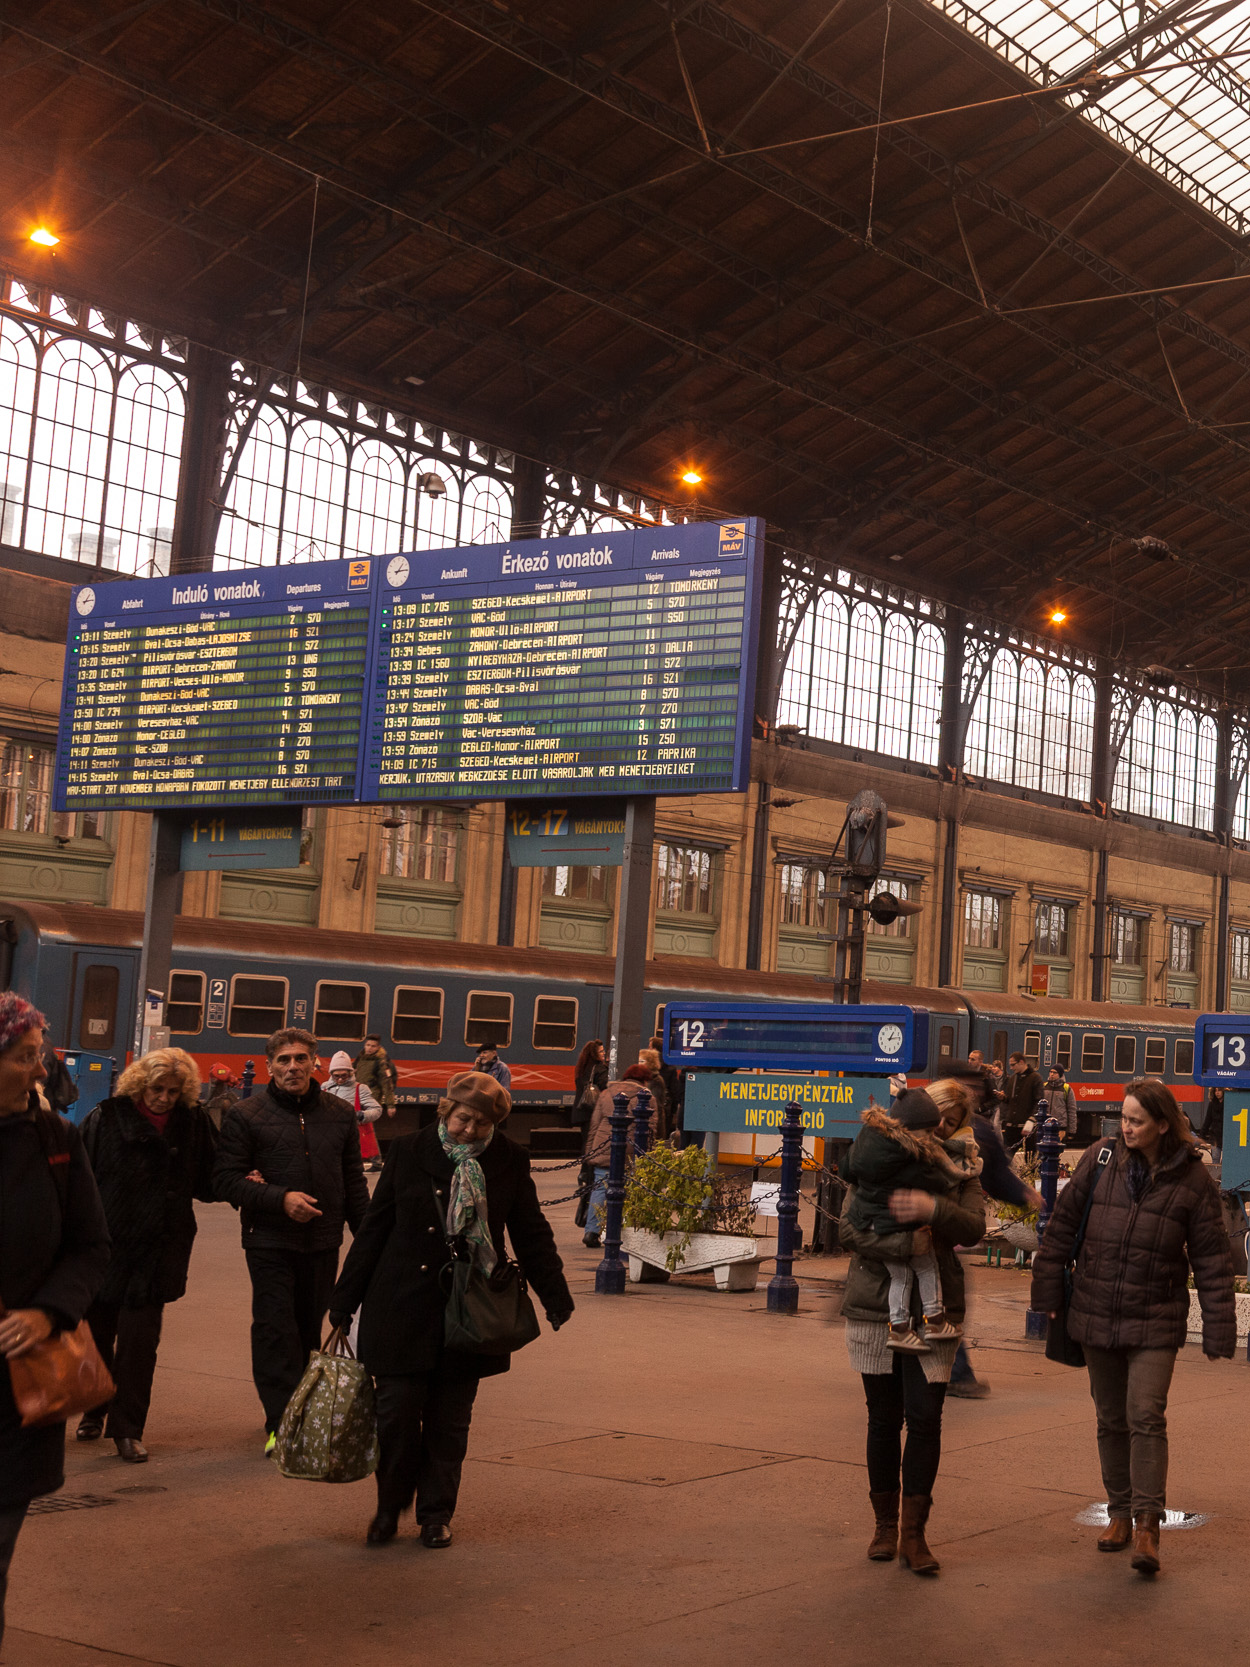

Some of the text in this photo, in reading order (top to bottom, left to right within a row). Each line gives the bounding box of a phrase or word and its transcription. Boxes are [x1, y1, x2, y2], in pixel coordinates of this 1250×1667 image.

[722, 540, 741, 551] MÁV
[501, 544, 613, 574] Érkező vonatok
[650, 547, 680, 560] Arrivals
[440, 567, 468, 579] Ankunft
[644, 571, 664, 582] Vágány
[350, 576, 366, 586] MÁV
[534, 581, 554, 590] Honnan
[171, 581, 261, 605] Induló vonatok
[286, 581, 322, 595] Departures
[648, 583, 659, 595] 12
[420, 592, 434, 600] Vonat
[668, 595, 685, 608] S70
[121, 598, 143, 609] Abfahrt
[421, 600, 449, 613] IC 705
[646, 598, 653, 609] 5
[393, 603, 416, 616] 13:09
[289, 614, 295, 625] 2
[306, 612, 321, 623] S70
[645, 613, 652, 624] 4
[667, 611, 684, 623] S50
[392, 617, 415, 630] 13:17
[81, 631, 99, 642] 13:11
[289, 627, 298, 638] 16
[305, 626, 319, 637] S21
[391, 631, 414, 643] 13:24
[645, 628, 655, 639] 11
[80, 643, 99, 655] 13:15
[288, 641, 292, 651] 1
[304, 639, 319, 650] S72
[416, 643, 441, 656] Sebes
[644, 643, 655, 654] 13
[390, 645, 413, 657] 13:34
[78, 656, 98, 667] 13:20
[287, 654, 296, 665] 13
[303, 653, 318, 664] UNG
[416, 657, 450, 670] IC 1560
[643, 658, 648, 669] 1
[664, 656, 681, 668] S72
[389, 660, 412, 671] 13:39
[77, 669, 97, 680] 13:20
[100, 667, 124, 678] IC 624
[285, 668, 291, 679] 9
[302, 666, 317, 678] S50
[388, 673, 411, 685] 13:39
[642, 673, 653, 685] 16
[663, 672, 679, 684] S21
[76, 682, 96, 693] 13:35
[283, 682, 290, 692] 5
[301, 680, 316, 691] S70
[386, 688, 409, 700] 13:44
[640, 689, 647, 700] 8
[661, 687, 679, 699] S70
[76, 695, 94, 705] 13:41
[283, 696, 293, 706] 12
[73, 708, 93, 718] 13:50
[96, 706, 120, 717] IC 734
[298, 708, 313, 719] S71
[385, 702, 408, 714] 13:47
[639, 704, 646, 715] 7
[660, 702, 678, 714] Z70
[281, 710, 288, 720] 4
[72, 721, 92, 731] 14:00
[297, 722, 312, 733] Z50
[384, 716, 407, 728] 13:54
[638, 719, 644, 730] 3
[659, 717, 675, 729] S71
[281, 723, 290, 733] 14
[71, 733, 91, 744] 14:00
[296, 736, 311, 746] Z70
[383, 730, 406, 742] 13:59
[638, 734, 648, 745] 15
[658, 732, 675, 744] Z50
[279, 737, 285, 747] 6
[70, 746, 89, 757] 14:07
[277, 750, 284, 761] 8
[295, 749, 310, 760] S70
[382, 744, 405, 756] 13:59
[637, 749, 647, 760] 12
[657, 747, 696, 759] PAPRIKA
[69, 760, 87, 770] 14:11
[293, 763, 307, 774] S21
[381, 759, 404, 770] 14:09
[408, 757, 437, 769] IC 715
[277, 764, 287, 774] 16
[68, 772, 87, 782] 14:15
[510, 808, 626, 836] 12-17 VÁGÁNYOKH
[190, 819, 293, 842] 1-11 VÁGÁNYOKHOZ
[213, 981, 224, 996] 2
[678, 1020, 705, 1048] 12
[1046, 1038, 1051, 1046] 2
[1211, 1035, 1246, 1067] 13
[719, 1081, 854, 1104] MENETJEGYPÉNZTÁR
[745, 1108, 825, 1129] INFORCIÓ
